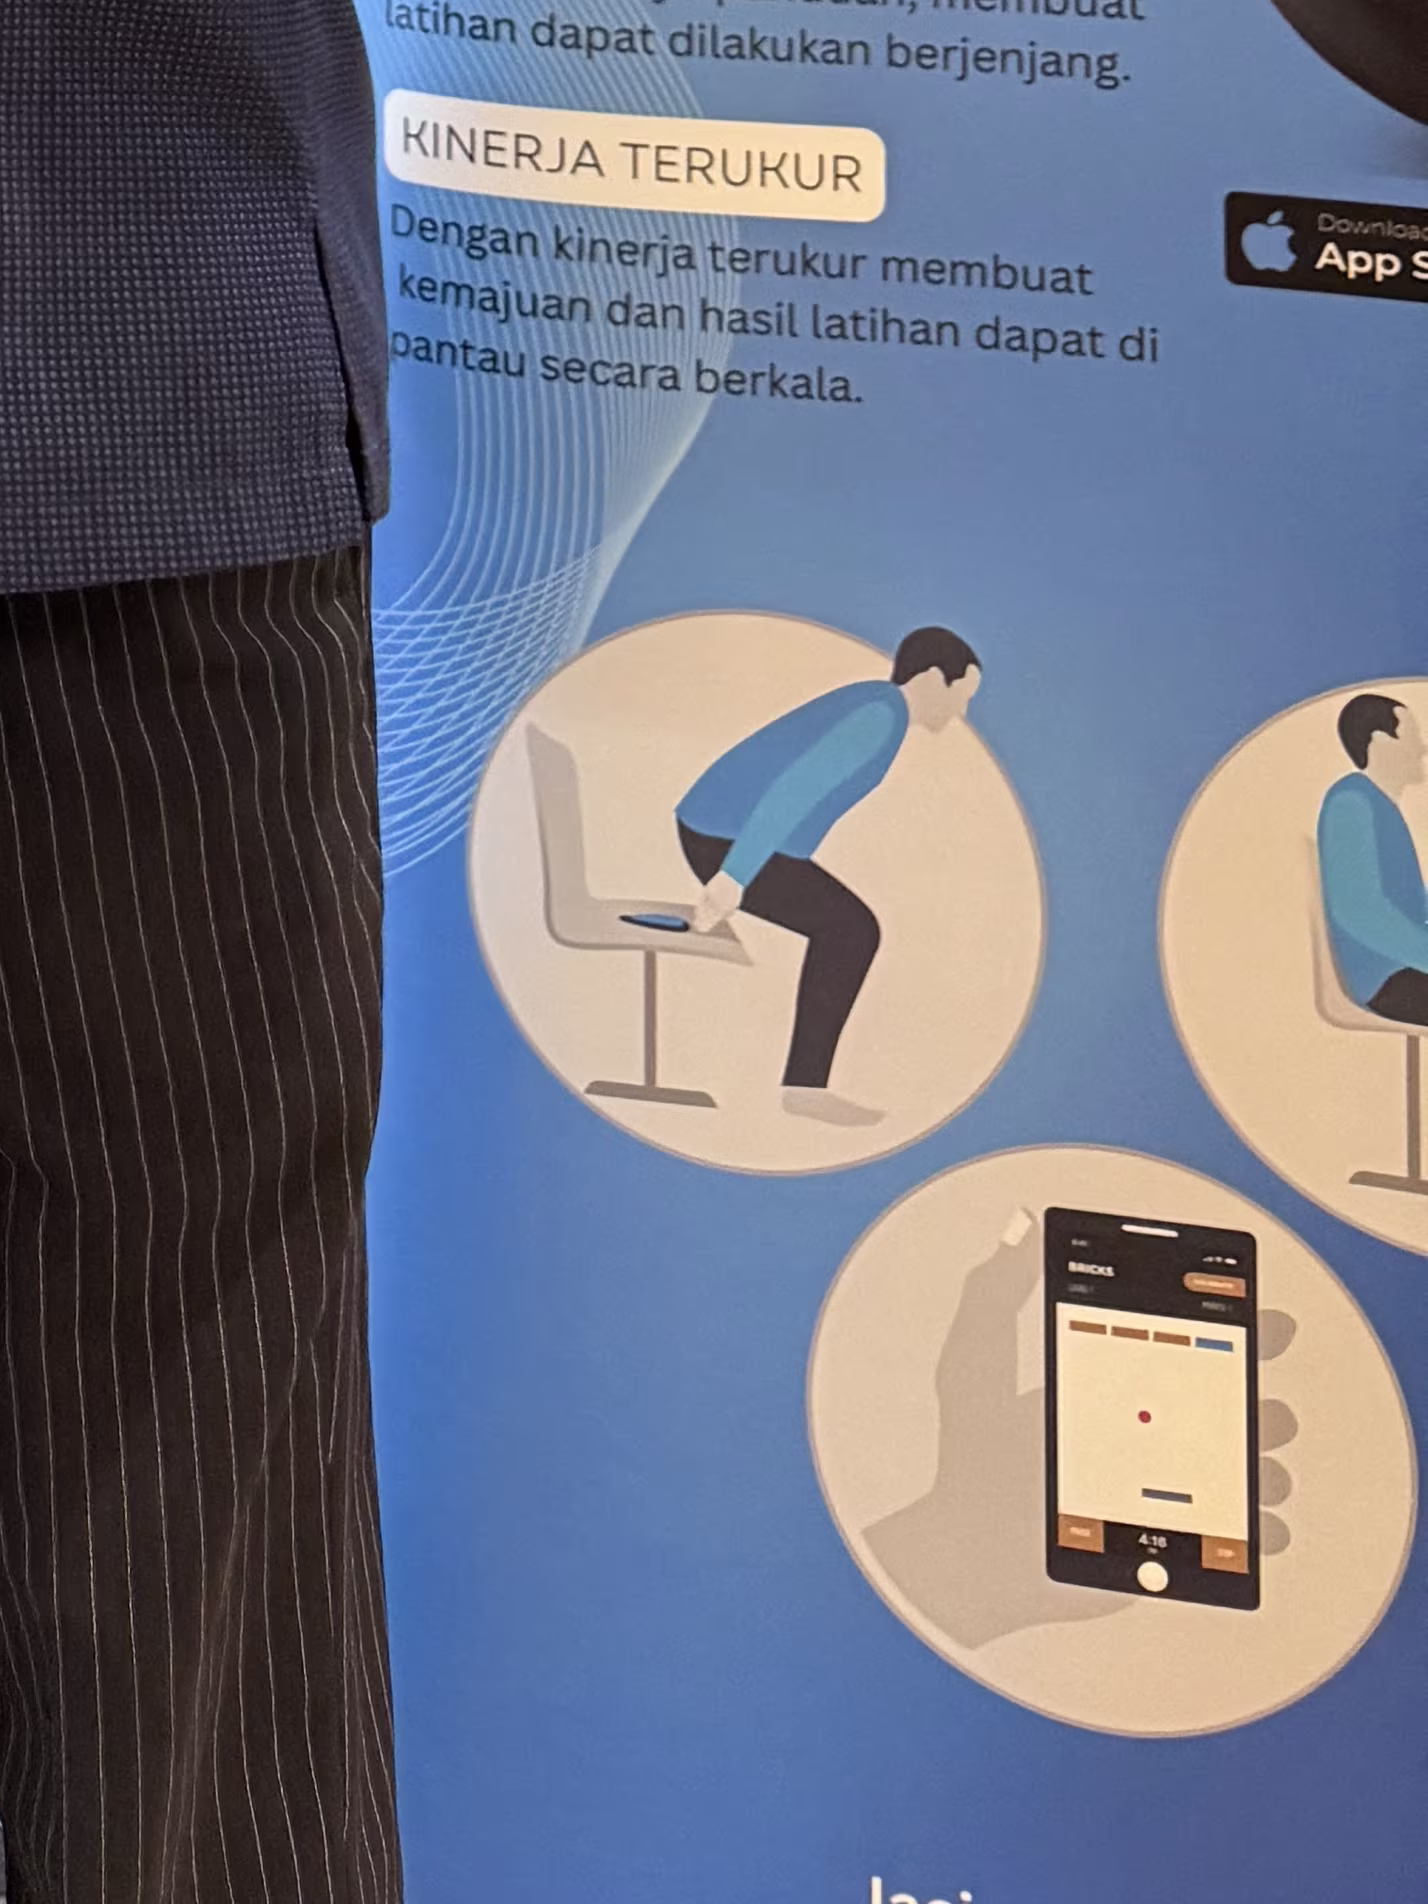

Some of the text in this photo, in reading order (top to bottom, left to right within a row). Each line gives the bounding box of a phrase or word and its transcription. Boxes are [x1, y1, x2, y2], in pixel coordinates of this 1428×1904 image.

[530, 11, 657, 60] dapat
[667, 22, 872, 66] dilakukan
[885, 31, 1133, 91] berjenjang.
[402, 115, 863, 193] KINERJA TERUKUR
[391, 202, 1096, 296] Dengan kinerja terukur membuat
[1314, 242, 1402, 283] App
[1317, 212, 1428, 242] Downloa
[398, 261, 1160, 364] kemajuan dan hasil latihan dapat di
[391, 329, 864, 404] pantau secara berkala.
[1067, 1260, 1116, 1278] BRICKS
